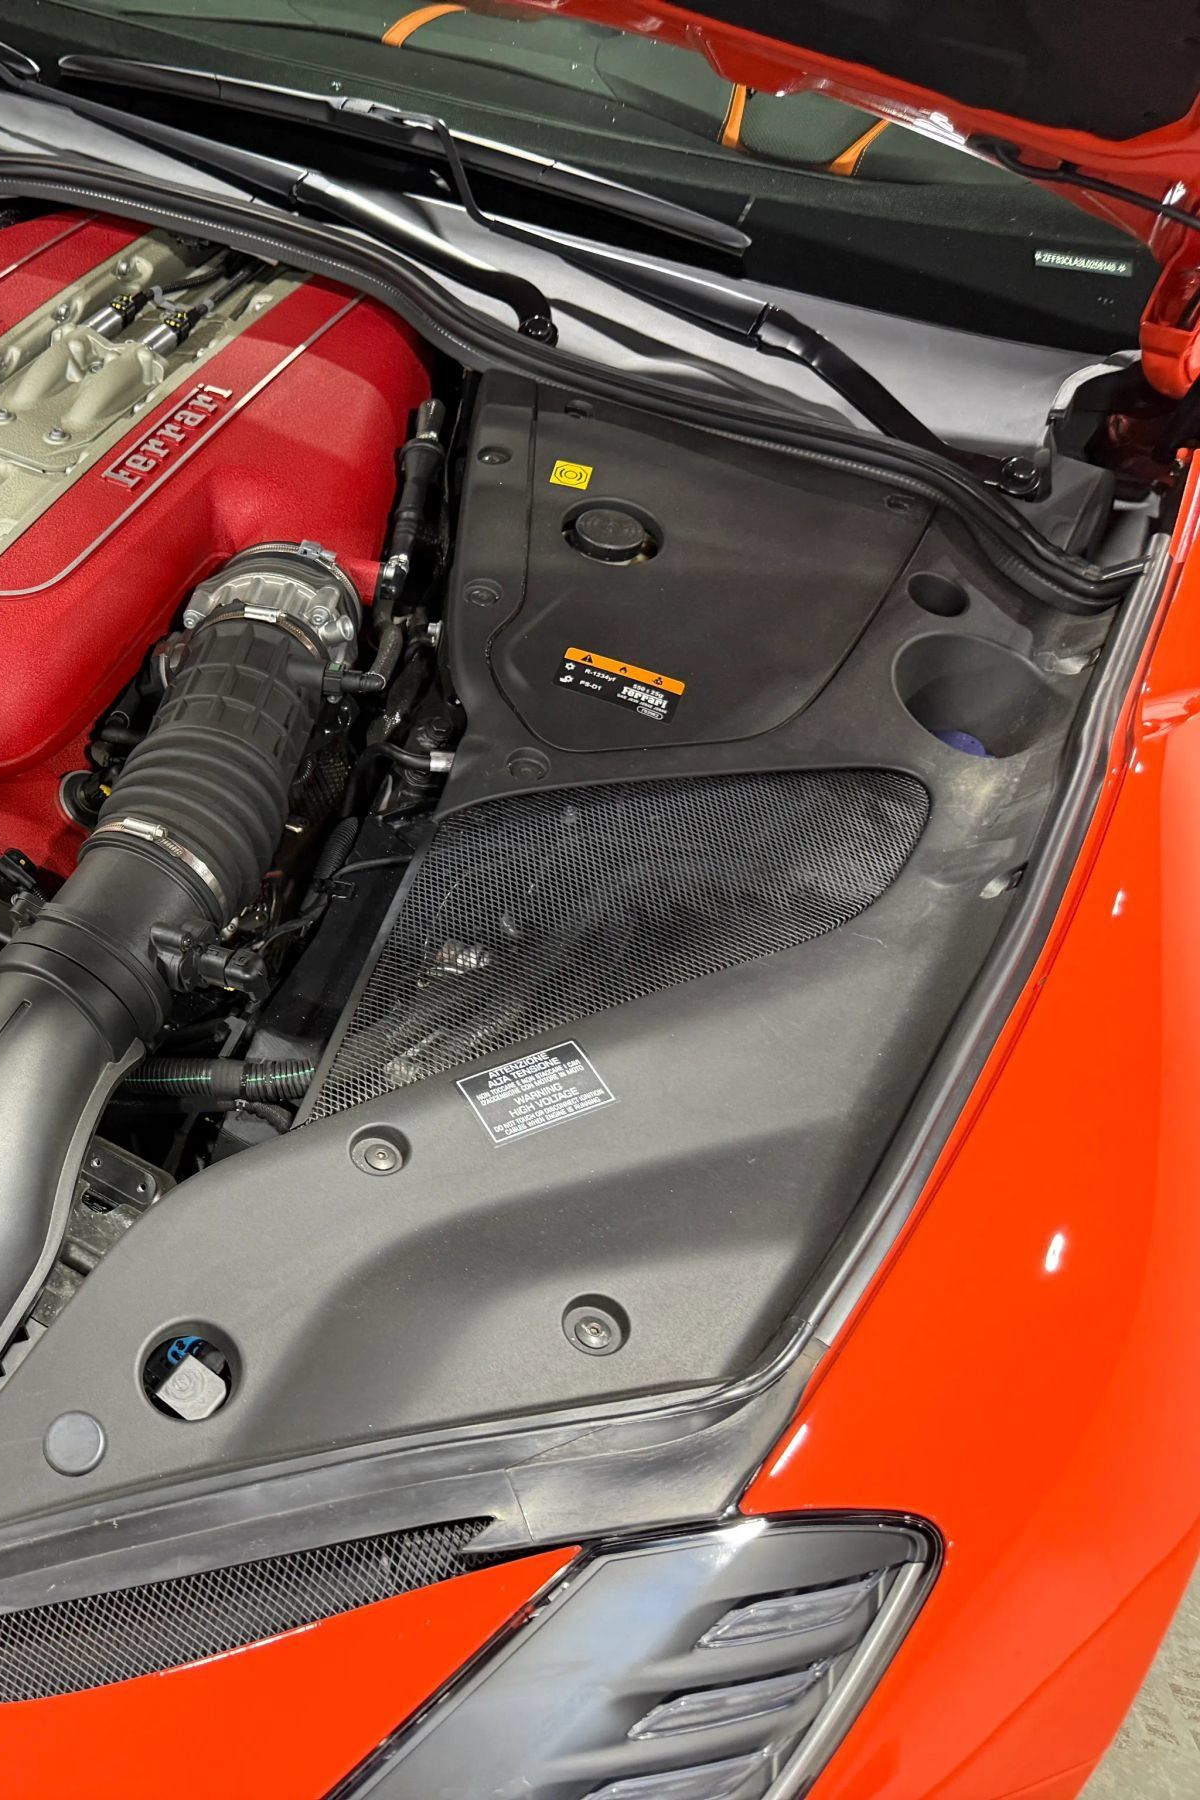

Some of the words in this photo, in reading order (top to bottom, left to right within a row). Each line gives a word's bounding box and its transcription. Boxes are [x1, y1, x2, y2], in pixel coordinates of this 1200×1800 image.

[101, 383, 233, 490] Ferrari
[584, 668, 617, 682] R-1234yf
[621, 686, 669, 708] Ferrari
[487, 1052, 550, 1079] ATTENZIONE
[487, 1075, 512, 1088] ALTA
[511, 1057, 561, 1079] TENSIONE
[520, 1082, 535, 1091] CON
[533, 1073, 559, 1086] MOTORE
[565, 1064, 584, 1075] MOTO
[475, 1091, 490, 1100] NON
[490, 1082, 516, 1095] TOCCARE
[520, 1075, 535, 1084] NON
[534, 1065, 563, 1079] STACCARE
[513, 1082, 563, 1105] WARNING
[502, 1120, 516, 1129] NOT
[515, 1113, 535, 1124] TOUCH
[543, 1096, 580, 1113] DISCONNECT
[577, 1087, 604, 1101] IGNITION
[504, 1123, 527, 1136] CABLES
[526, 1116, 546, 1127] WHEN
[544, 1108, 567, 1120] ENGINE
[572, 1095, 601, 1110] RUNNING
[508, 1102, 536, 1118] HIGH
[534, 1086, 580, 1108] VOLTAGE
